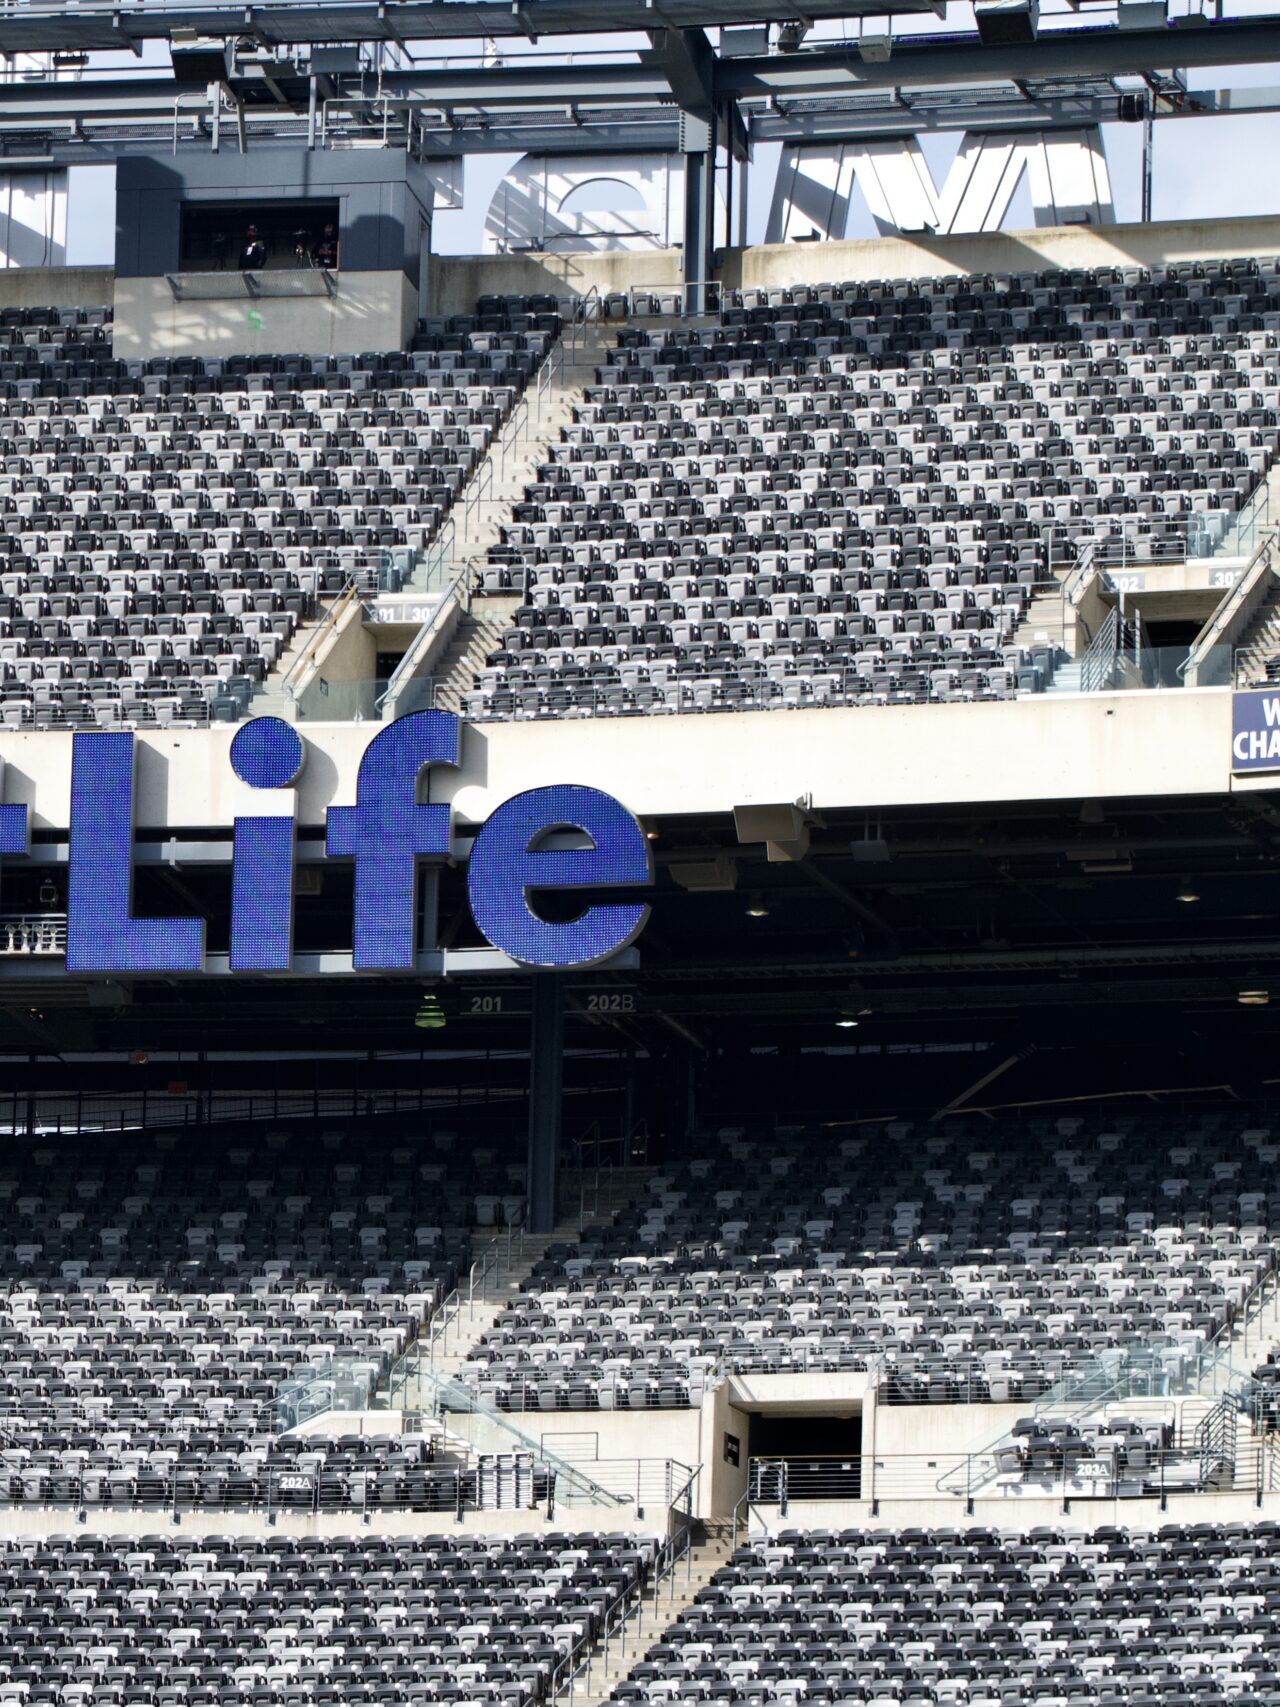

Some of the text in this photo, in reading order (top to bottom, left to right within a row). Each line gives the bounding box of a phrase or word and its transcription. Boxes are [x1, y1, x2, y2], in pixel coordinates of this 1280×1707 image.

[412, 607, 435, 622] 30
[471, 997, 502, 1012] 201
[587, 995, 634, 1011] 202B
[1077, 1464, 1108, 1476] 203A
[281, 1477, 311, 1488] 202A
